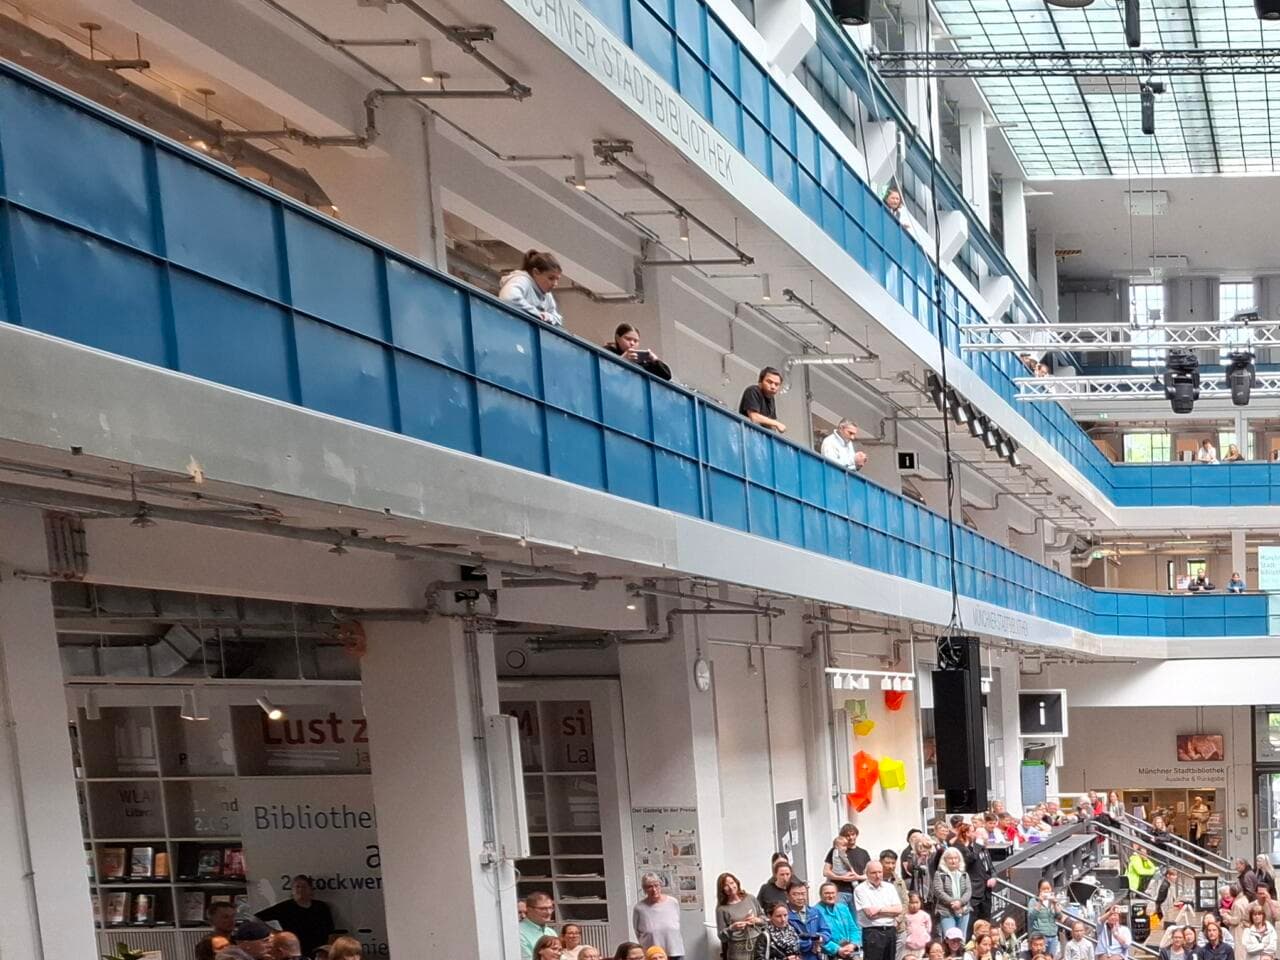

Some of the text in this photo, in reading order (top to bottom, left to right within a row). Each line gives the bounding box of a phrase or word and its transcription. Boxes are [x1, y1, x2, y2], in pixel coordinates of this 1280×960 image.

[601, 38, 735, 185] STADTBIBLIOTHEK
[262, 711, 369, 745] Lust z
[1138, 766, 1225, 775] Münchner Stadtbibliothek
[365, 844, 382, 869] a
